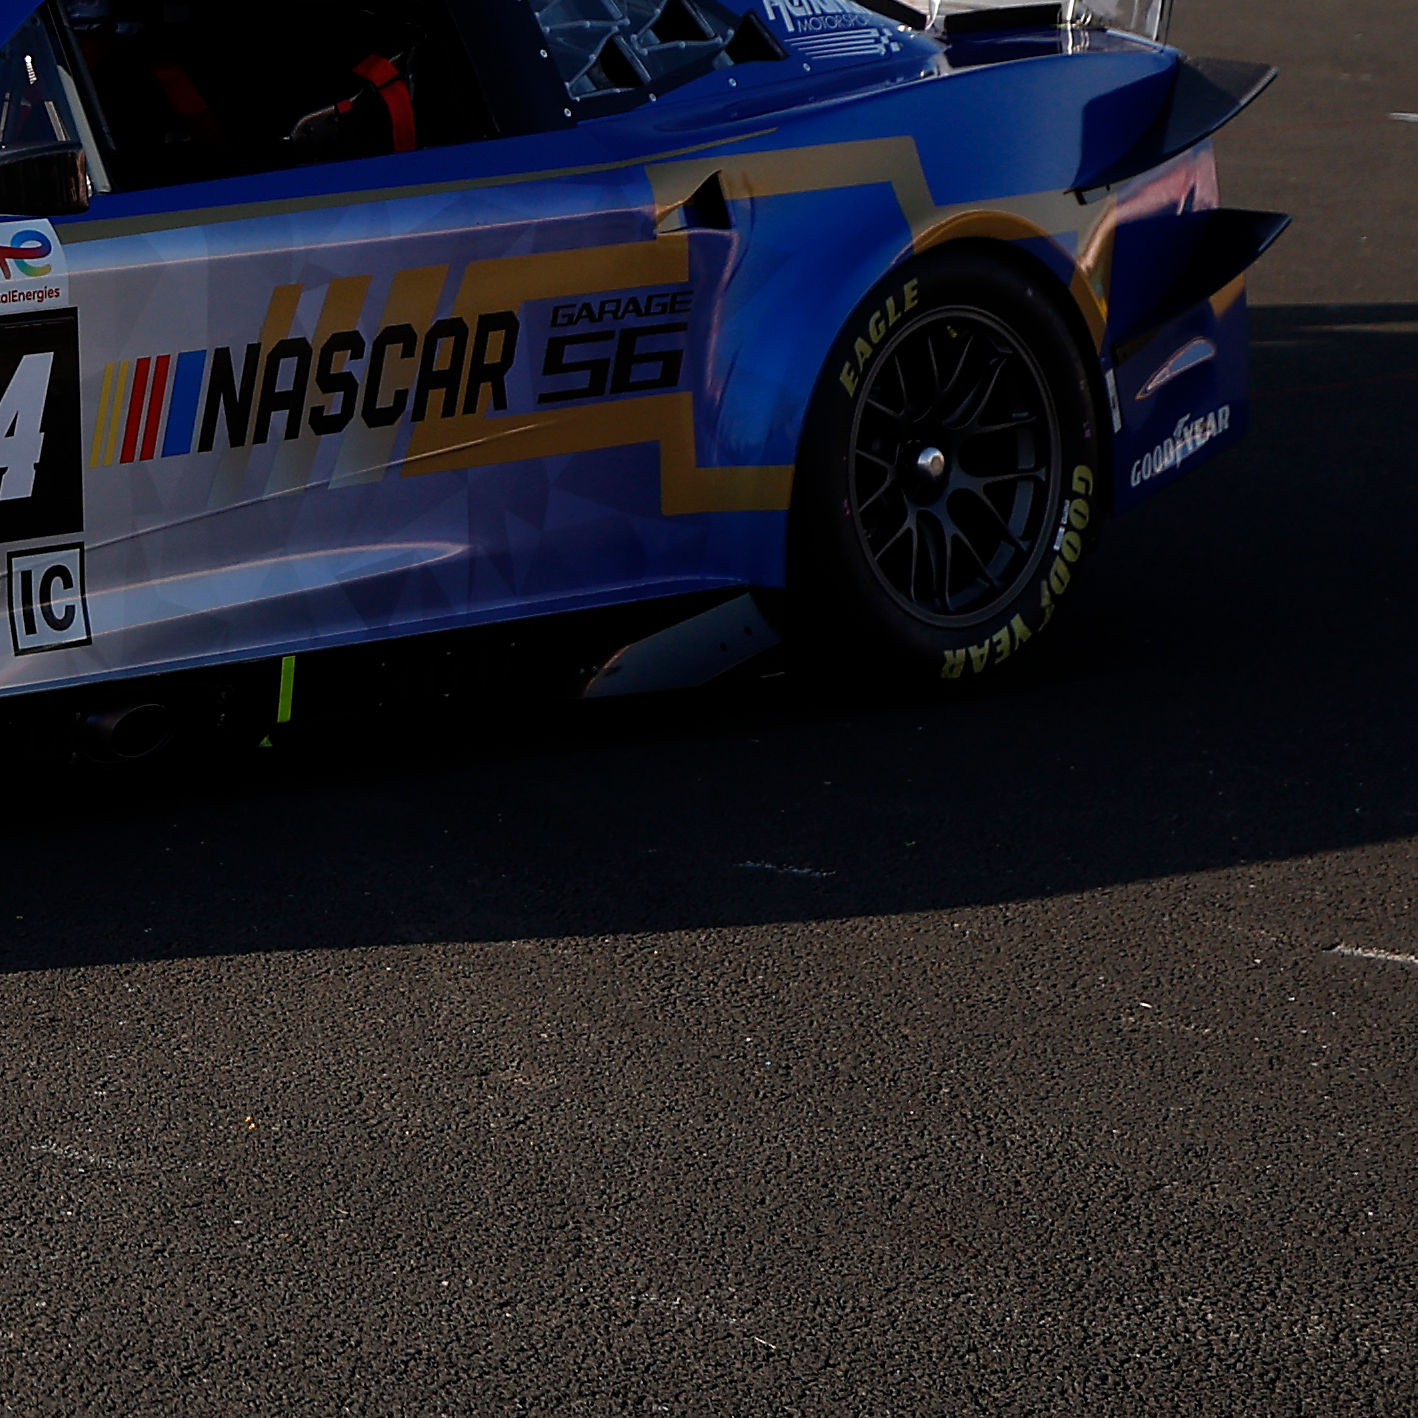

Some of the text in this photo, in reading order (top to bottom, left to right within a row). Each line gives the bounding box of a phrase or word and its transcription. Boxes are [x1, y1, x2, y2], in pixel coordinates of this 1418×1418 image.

[550, 290, 695, 329] GARAGE
[840, 278, 919, 398] EAGLE
[198, 311, 520, 454] NASCAR
[536, 321, 689, 408] 56
[20, 564, 76, 636] IC
